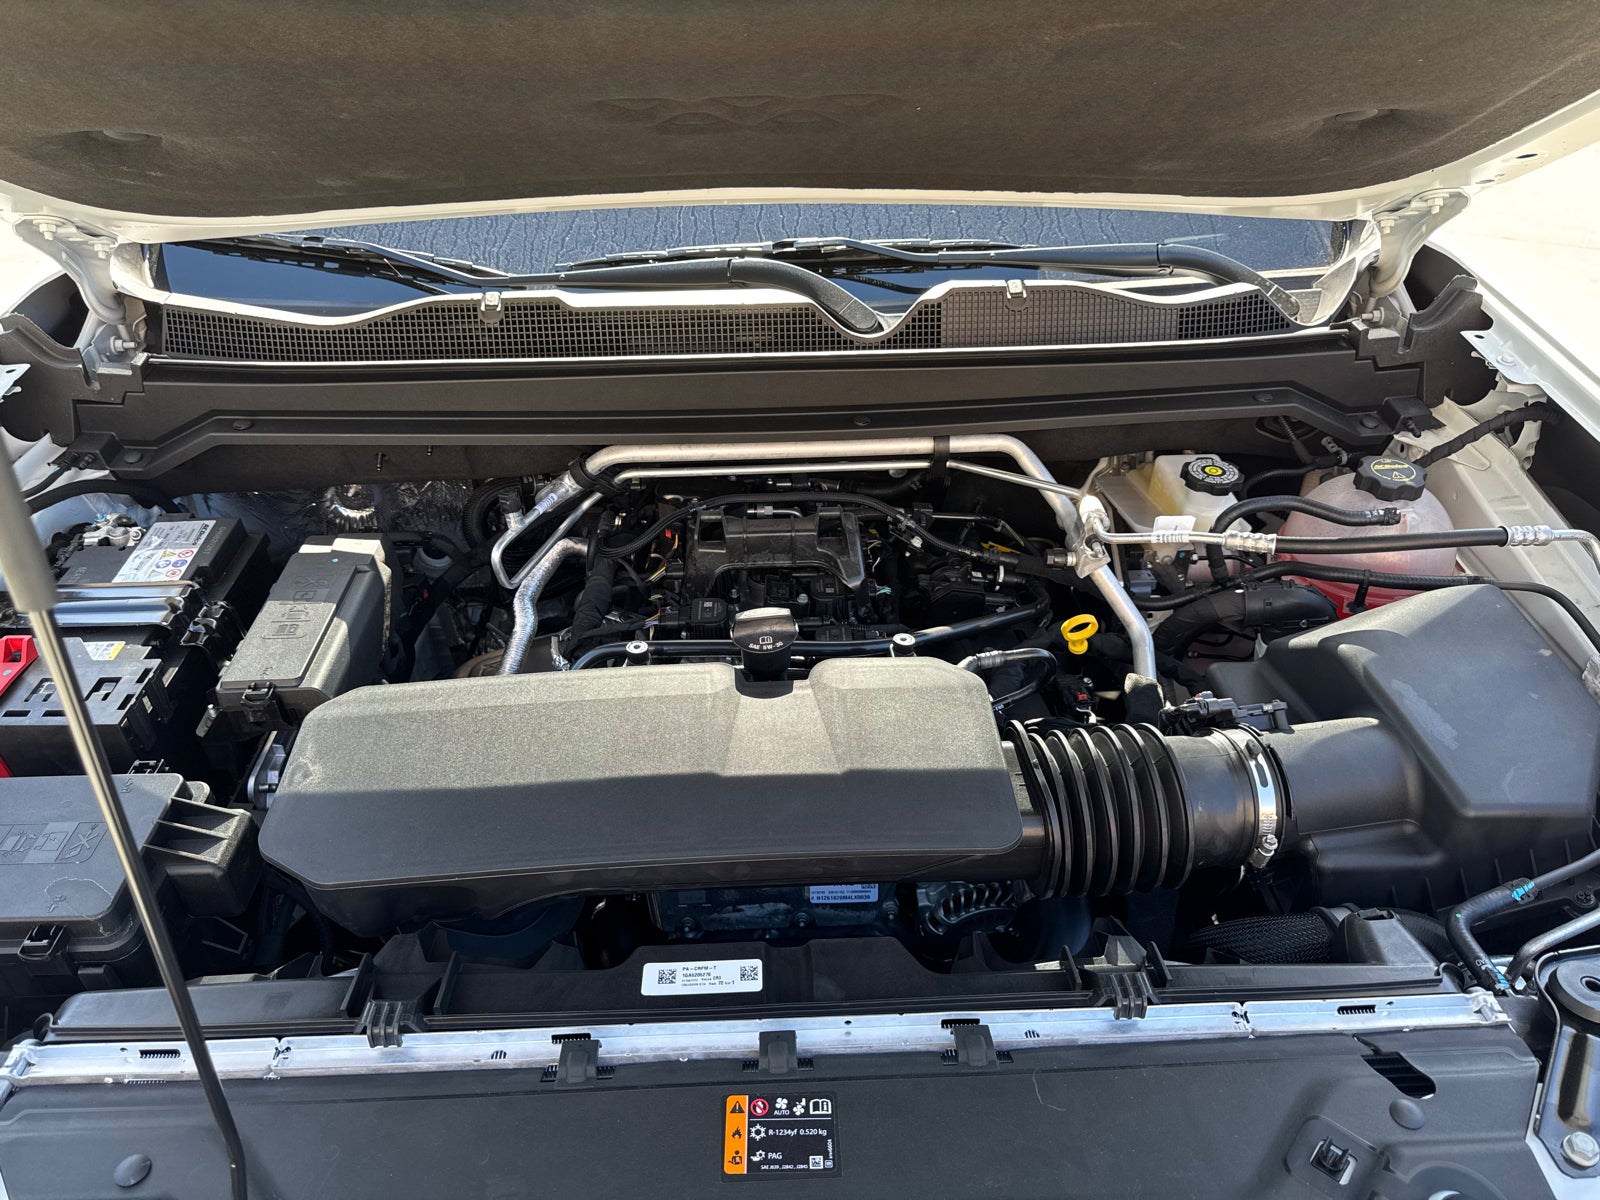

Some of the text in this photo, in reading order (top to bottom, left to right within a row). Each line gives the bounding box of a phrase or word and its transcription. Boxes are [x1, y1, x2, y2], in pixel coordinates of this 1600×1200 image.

[748, 641, 784, 650] SAE 5W-30
[818, 1128, 827, 1137] kg
